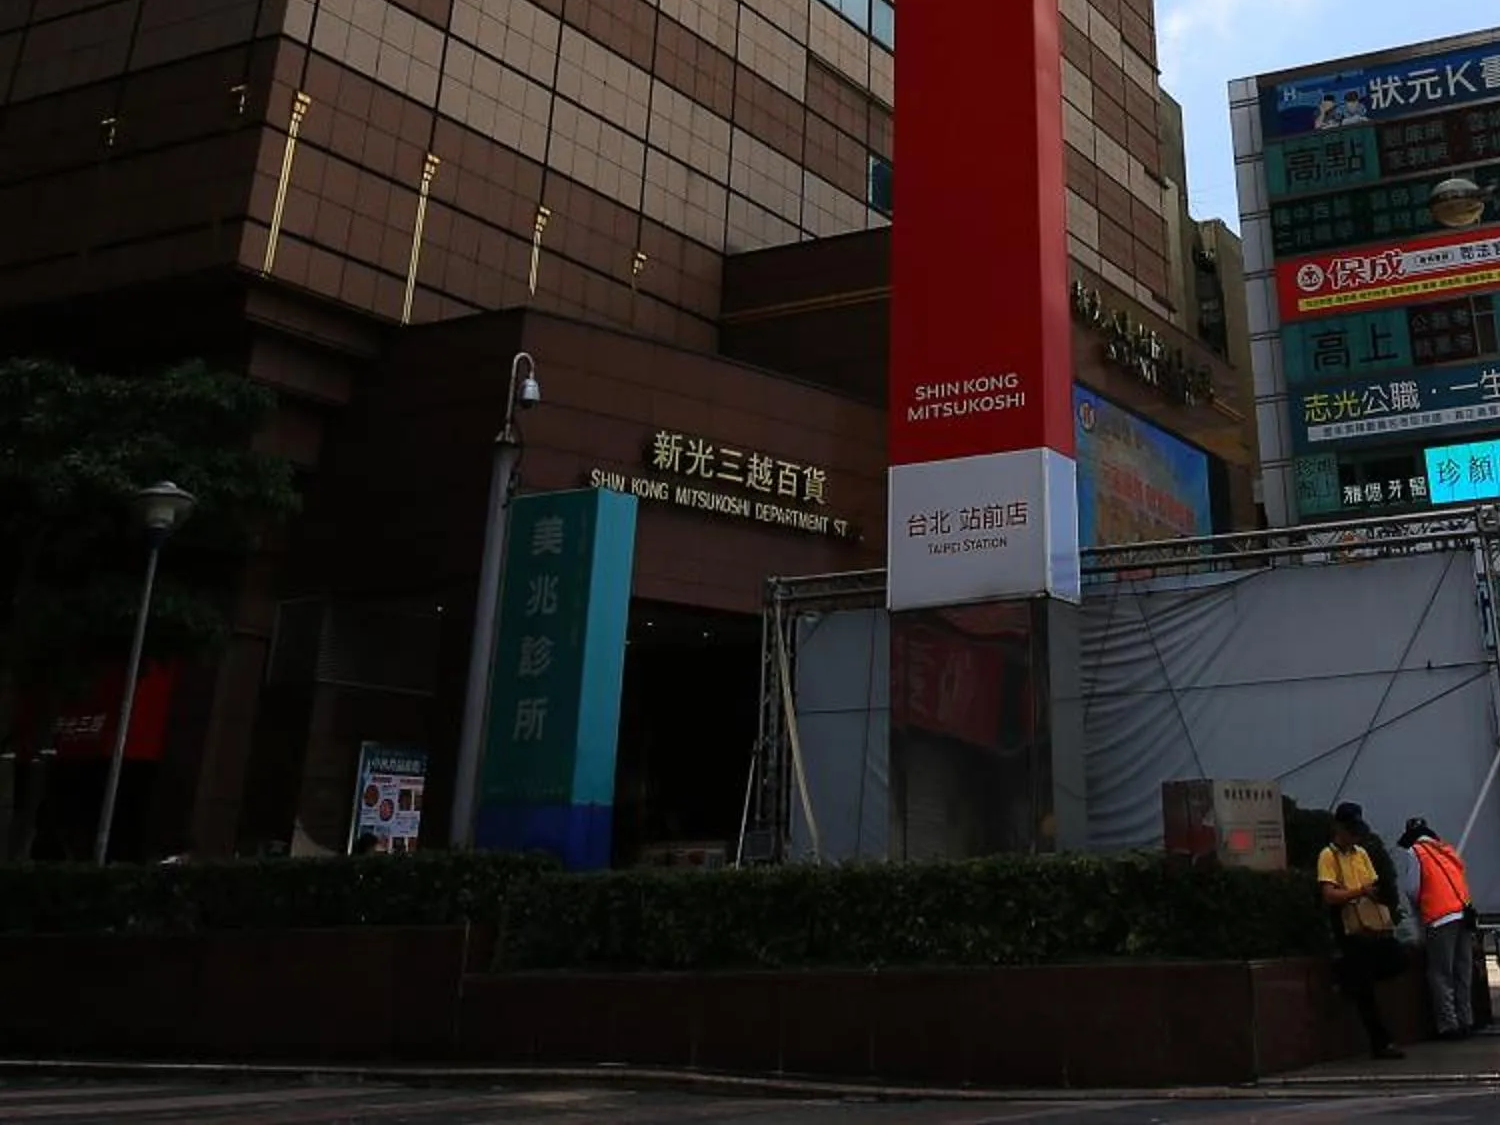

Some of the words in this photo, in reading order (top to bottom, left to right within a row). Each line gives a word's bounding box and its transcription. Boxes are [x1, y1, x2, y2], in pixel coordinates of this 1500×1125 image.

[1284, 135, 1366, 187] 高點
[1326, 248, 1407, 290] 保成
[1311, 322, 1400, 371] 高上
[907, 392, 1026, 422] MITSUKOSHI
[915, 378, 960, 401] SHIN
[963, 373, 1018, 394] KONG
[652, 429, 827, 506] 新光三越百貨
[590, 467, 625, 492] SHIN
[631, 477, 669, 502] KONG
[675, 486, 750, 518] MITSUKOSHI
[755, 502, 828, 535] DEPARTMENT
[907, 511, 951, 538] 台北
[959, 502, 1028, 532] 站前店
[927, 542, 961, 556] TAIPEI
[963, 537, 1007, 552] STATION
[512, 515, 566, 742] 美兆診所
